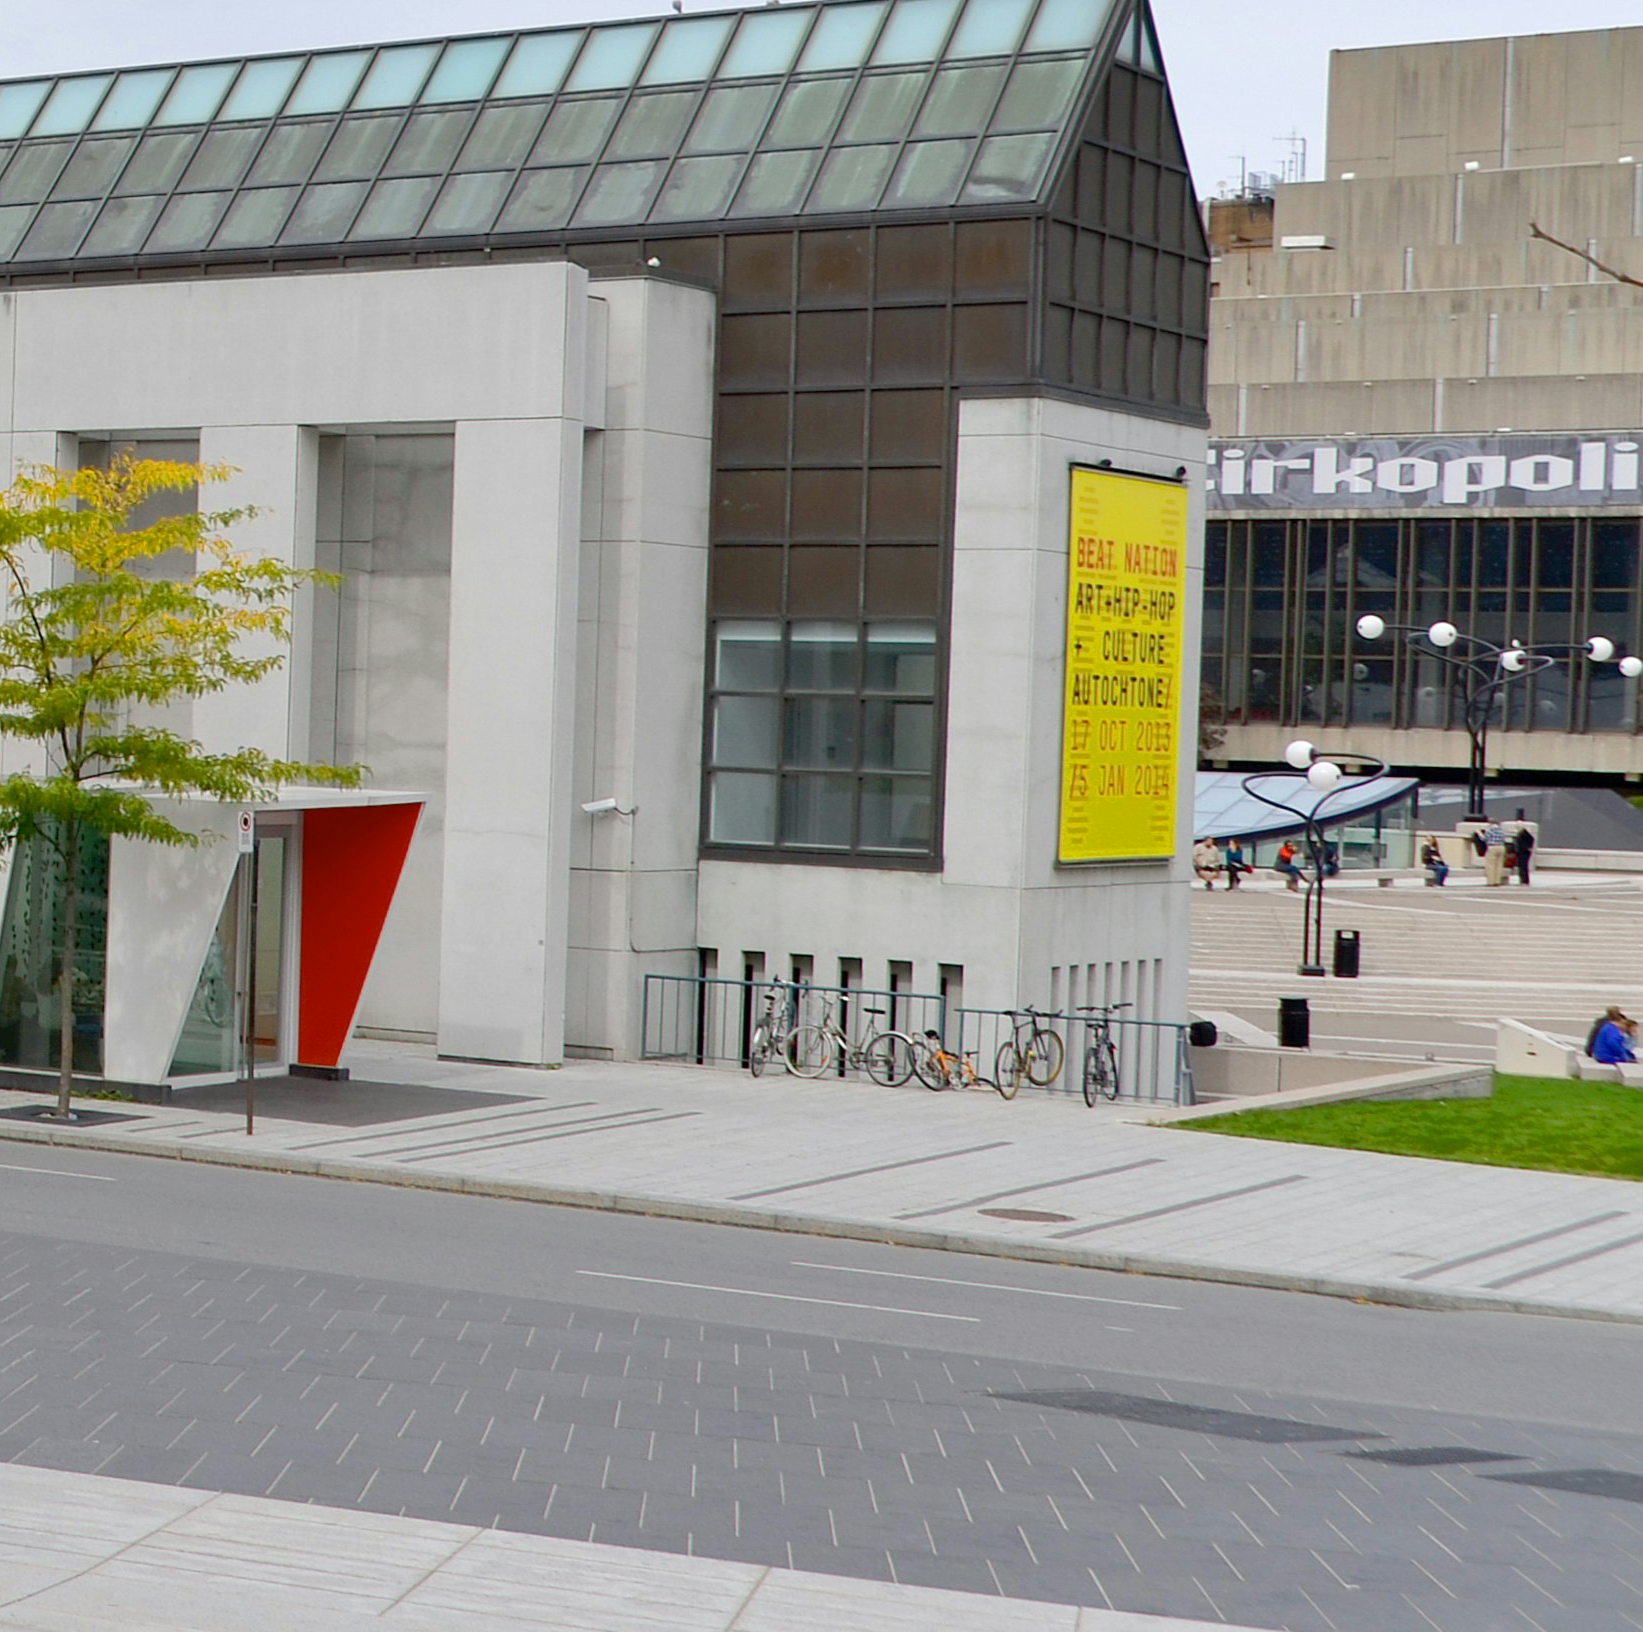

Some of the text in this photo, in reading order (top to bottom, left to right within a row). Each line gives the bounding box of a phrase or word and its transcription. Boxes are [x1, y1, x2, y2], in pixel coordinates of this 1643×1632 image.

[1077, 536, 1177, 578] BEAT NATION
[1102, 629, 1166, 665] CULTURE
[1071, 719, 1171, 752] 17 OCT 2013
[1099, 764, 1126, 796] JAN
[1135, 764, 1170, 800] 2014
